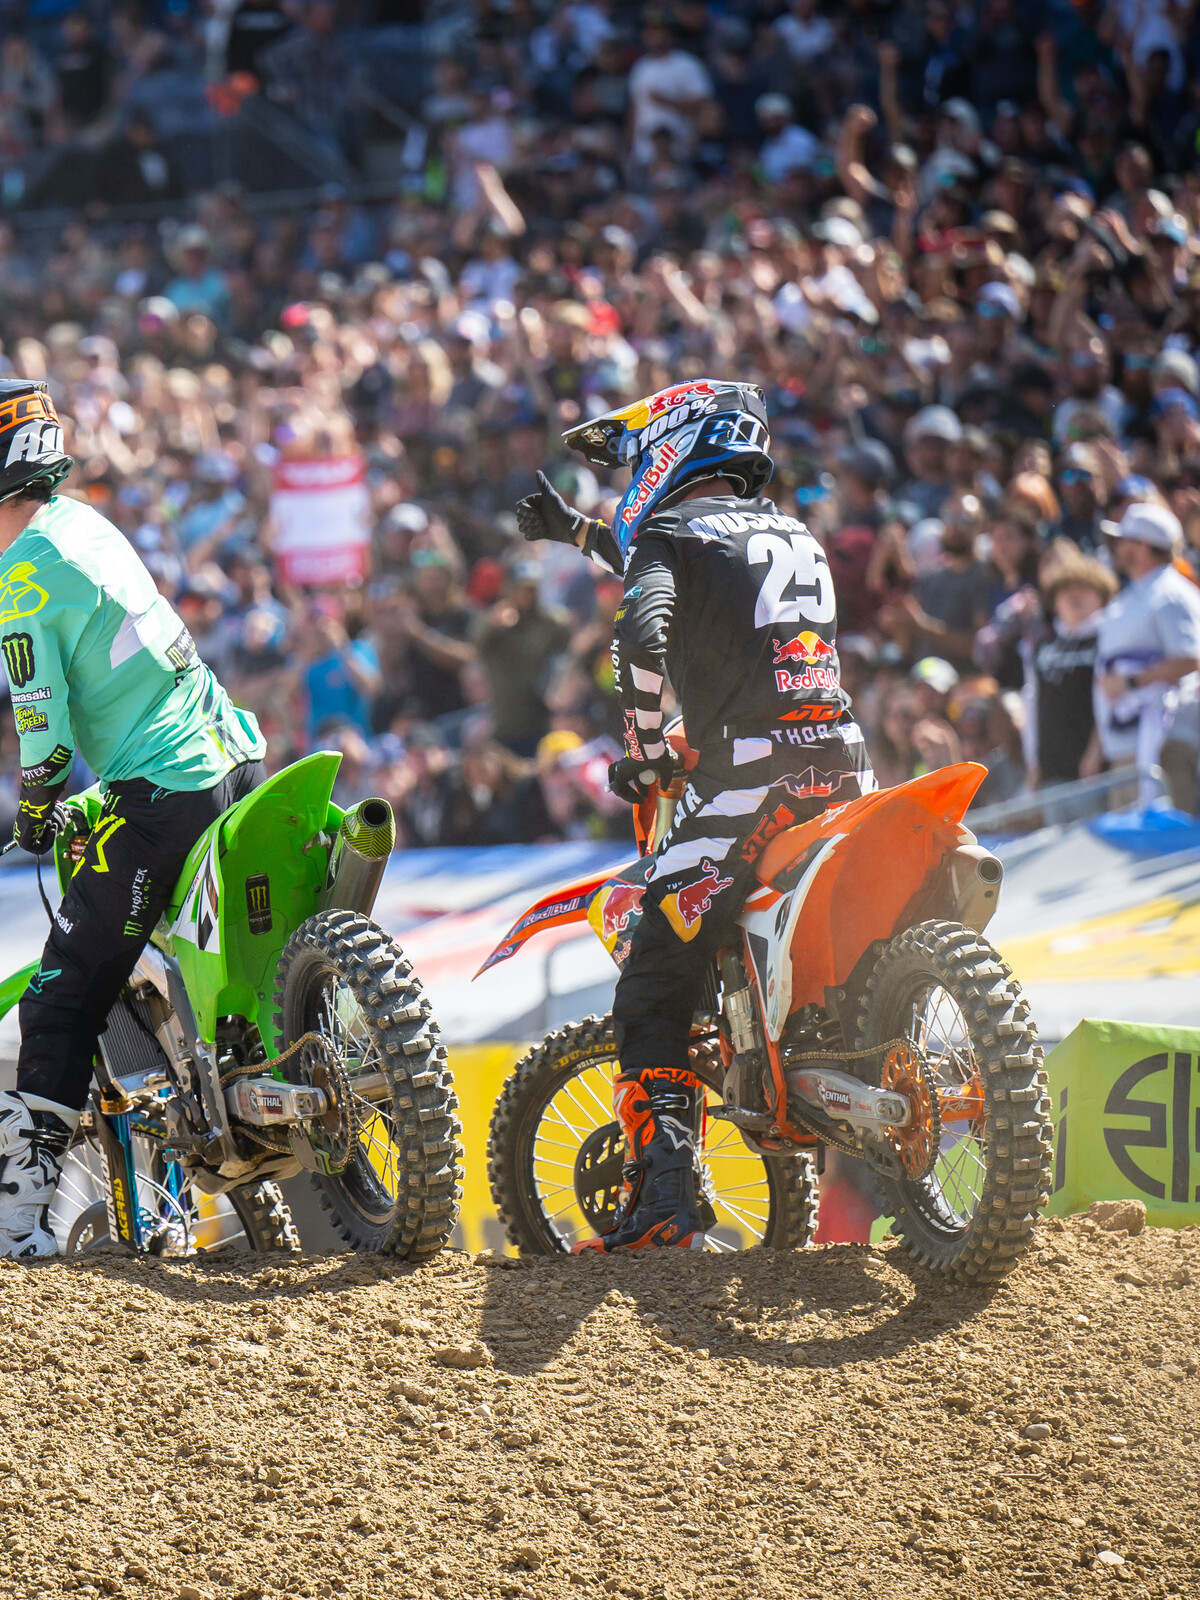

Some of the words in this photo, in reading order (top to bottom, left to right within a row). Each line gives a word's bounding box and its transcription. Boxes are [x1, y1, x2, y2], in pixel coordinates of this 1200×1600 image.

[639, 396, 718, 452] 100%
[622, 485, 650, 527] Red
[642, 441, 679, 488] Bull
[746, 532, 837, 630] 25
[774, 666, 816, 693] Red
[11, 687, 51, 703] awasaki
[15, 707, 35, 722] TEAM
[18, 714, 46, 732] GREEN
[770, 723, 831, 745] THOR
[523, 907, 551, 928] Red
[550, 897, 580, 917] Bull
[558, 1042, 617, 1068] DUNLO
[99, 1143, 119, 1243] DUNLOP
[113, 1178, 130, 1241] ACERBIS
